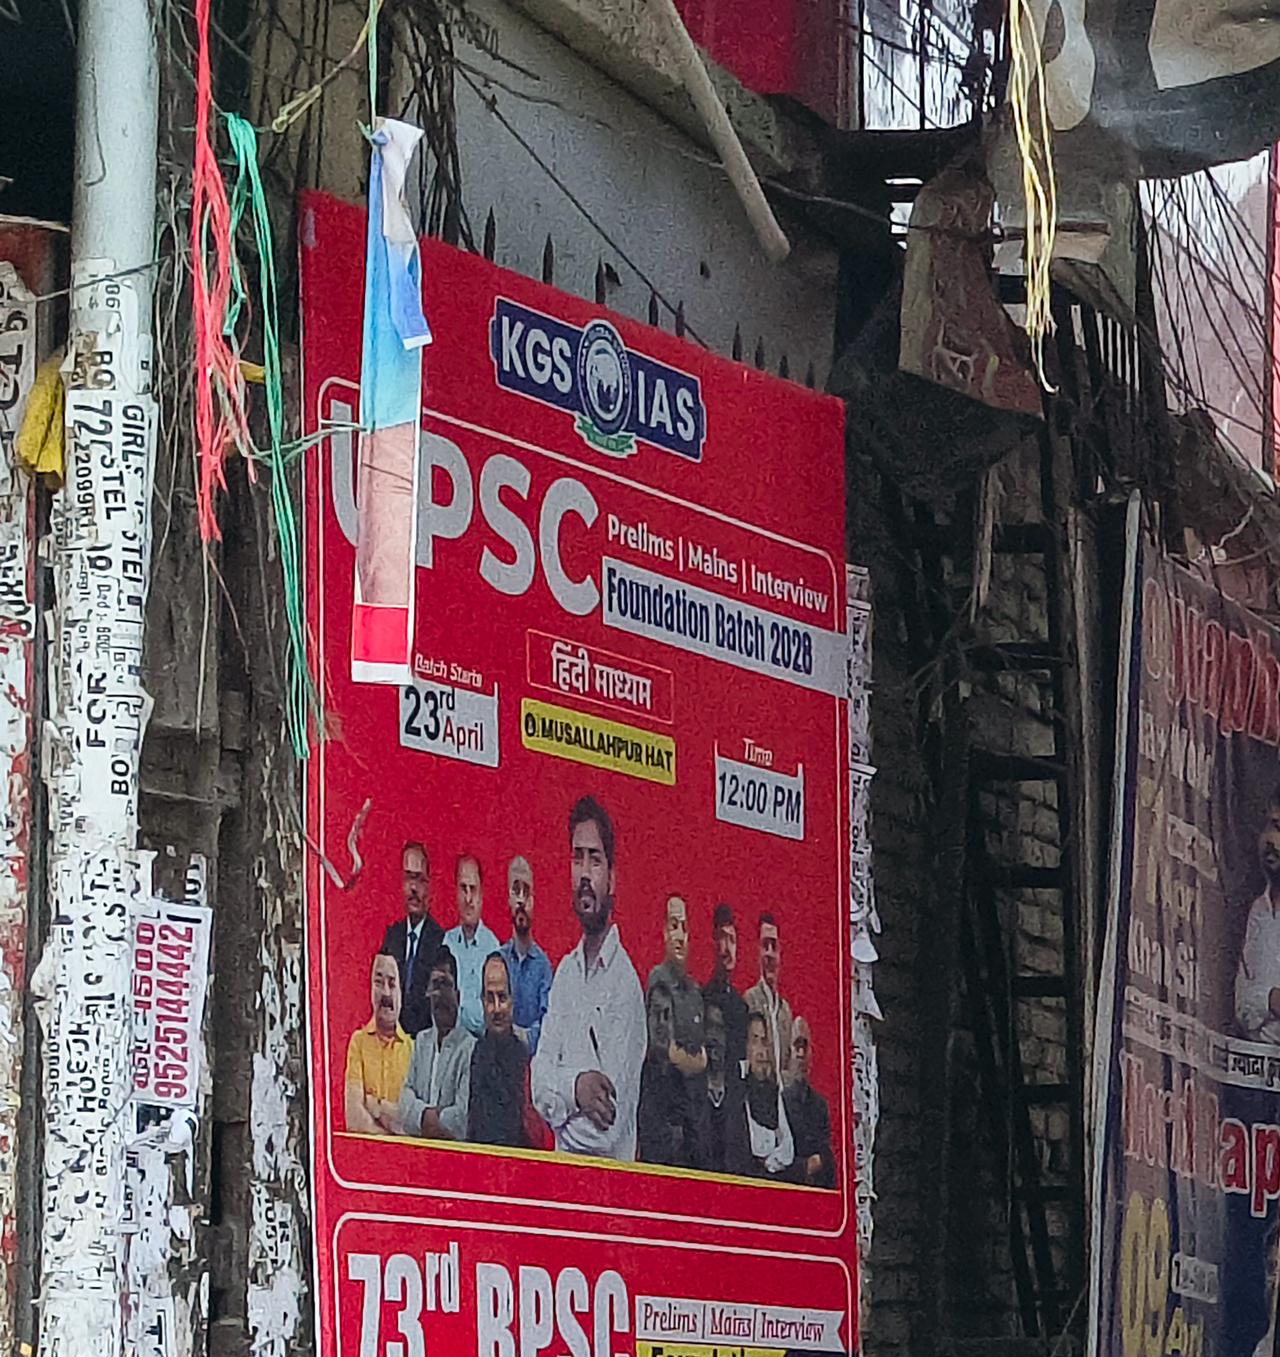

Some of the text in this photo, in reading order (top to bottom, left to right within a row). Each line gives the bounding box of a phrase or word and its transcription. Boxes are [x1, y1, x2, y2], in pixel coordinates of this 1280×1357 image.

[501, 315, 573, 394] KGS
[637, 370, 695, 442] IAS
[607, 513, 829, 613] Prelims Mains Interview
[607, 566, 711, 644] Foundation
[715, 602, 766, 662] Batch
[551, 641, 652, 711] हिंदी माध्यम
[403, 684, 484, 754] 23rd April
[541, 719, 673, 773] MUSALLAHPUR HAT
[718, 770, 802, 824] 12:00 PM
[154, 923, 194, 1099] 9525144442
[643, 1302, 698, 1334] Prelims
